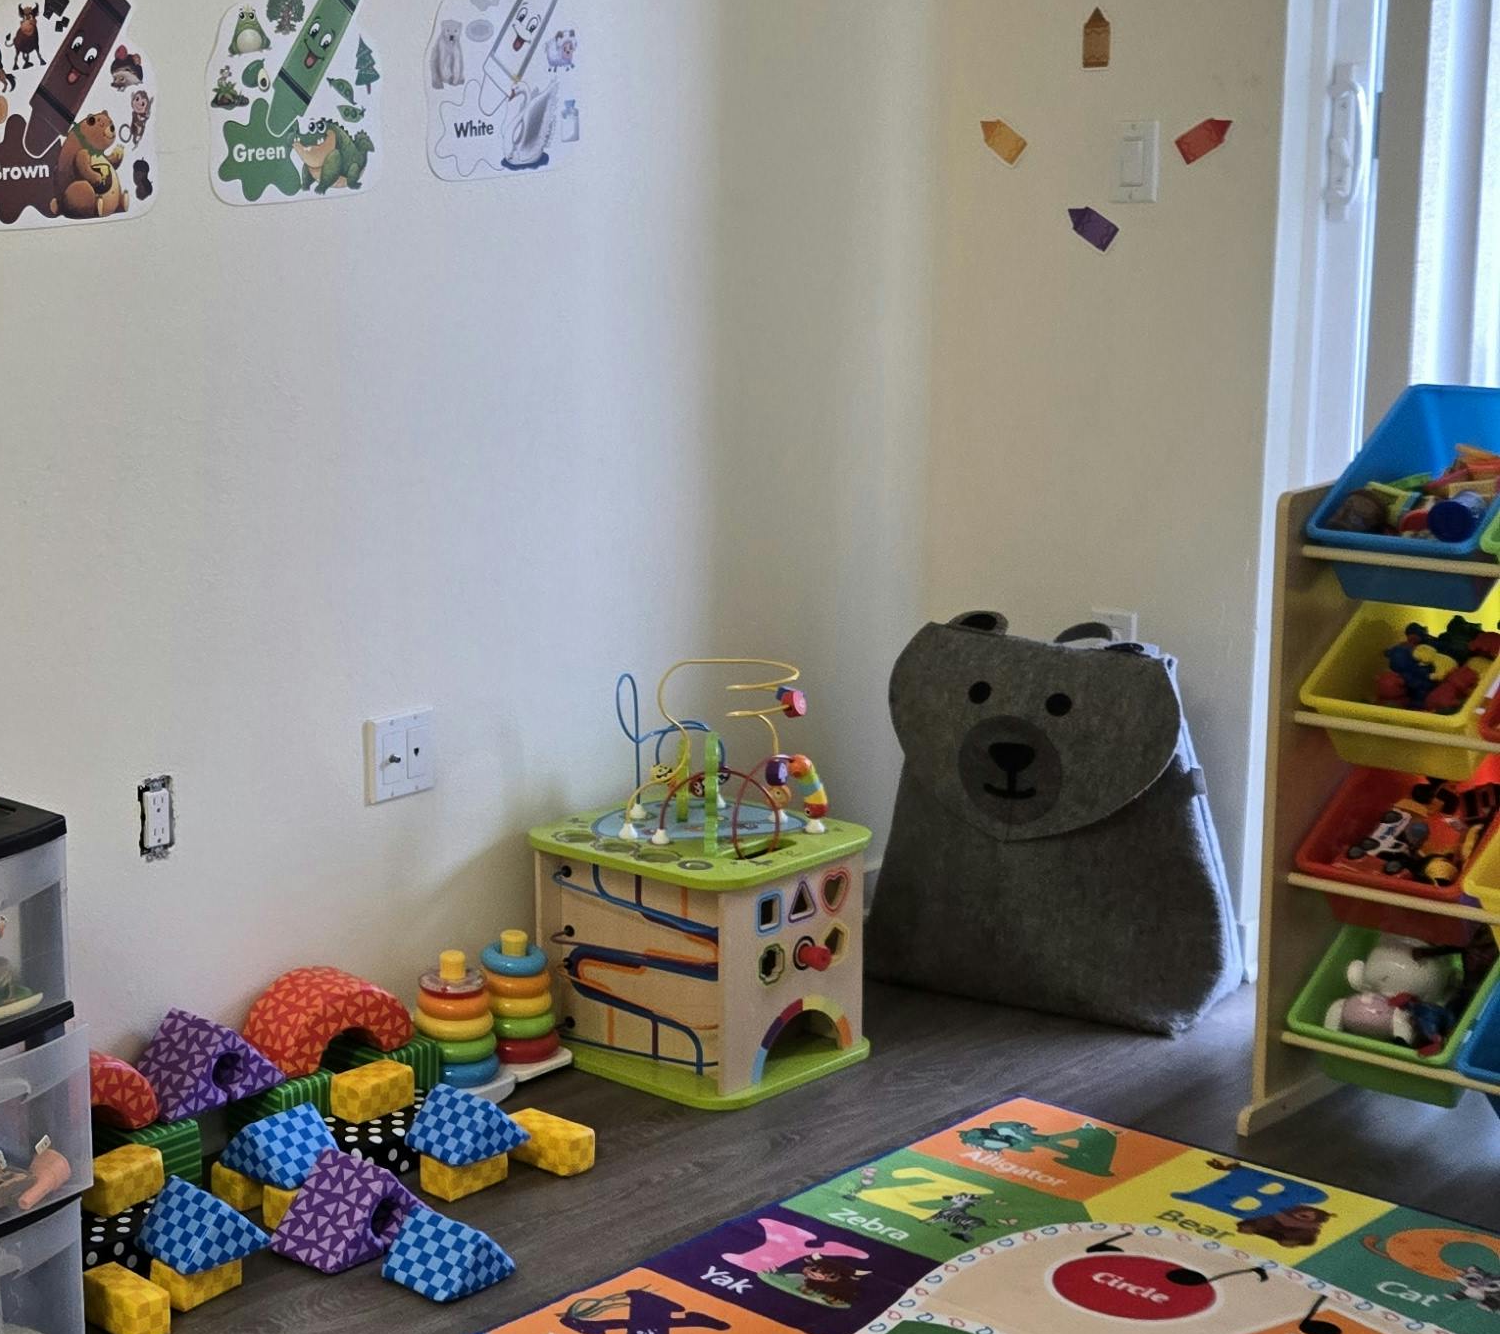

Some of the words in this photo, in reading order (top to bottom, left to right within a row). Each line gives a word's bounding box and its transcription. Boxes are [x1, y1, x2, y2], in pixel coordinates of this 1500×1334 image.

[454, 120, 495, 139] White
[232, 143, 286, 163] Green
[959, 1150, 1067, 1187] Alligator
[827, 1207, 910, 1242] Zebra
[1155, 1209, 1236, 1241] Bear
[700, 1265, 754, 1295] Yak
[1091, 1271, 1171, 1306] Circle
[1377, 1281, 1439, 1307] Cat
